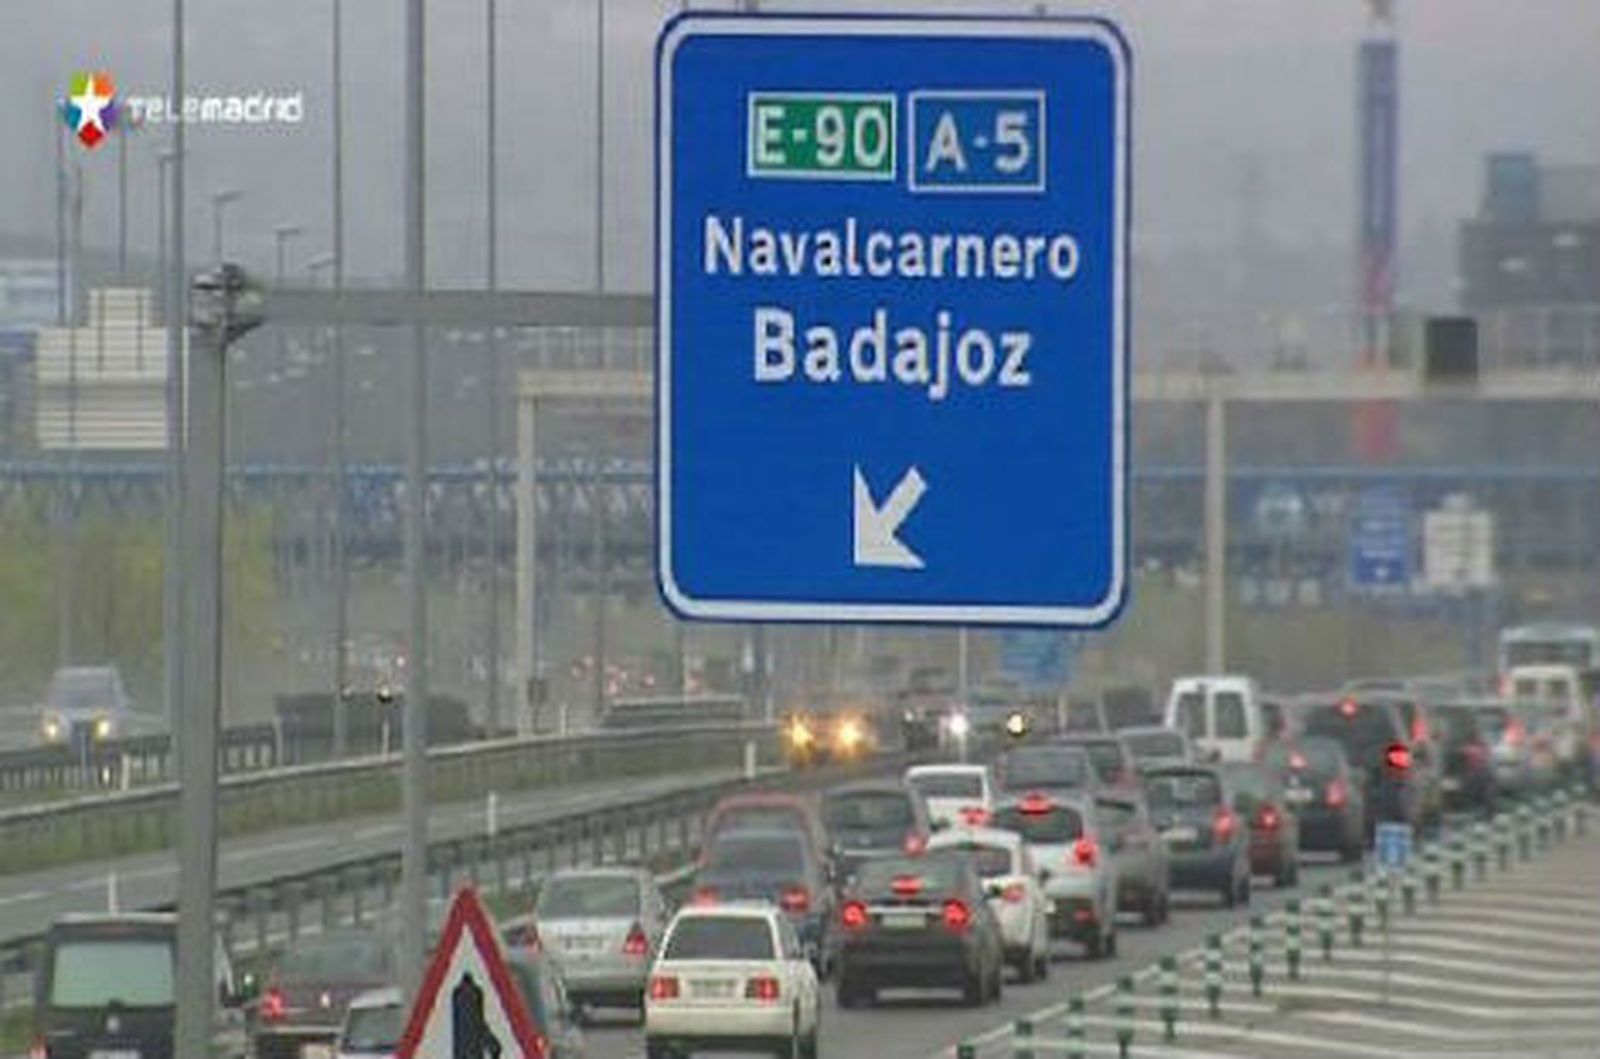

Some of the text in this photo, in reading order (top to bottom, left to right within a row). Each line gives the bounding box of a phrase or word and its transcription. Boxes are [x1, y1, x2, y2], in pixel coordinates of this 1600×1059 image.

[754, 105, 889, 167] E-90
[925, 111, 1030, 172] A-5
[704, 215, 1080, 279] Navalcarnero
[753, 307, 1032, 400] Badajoz
